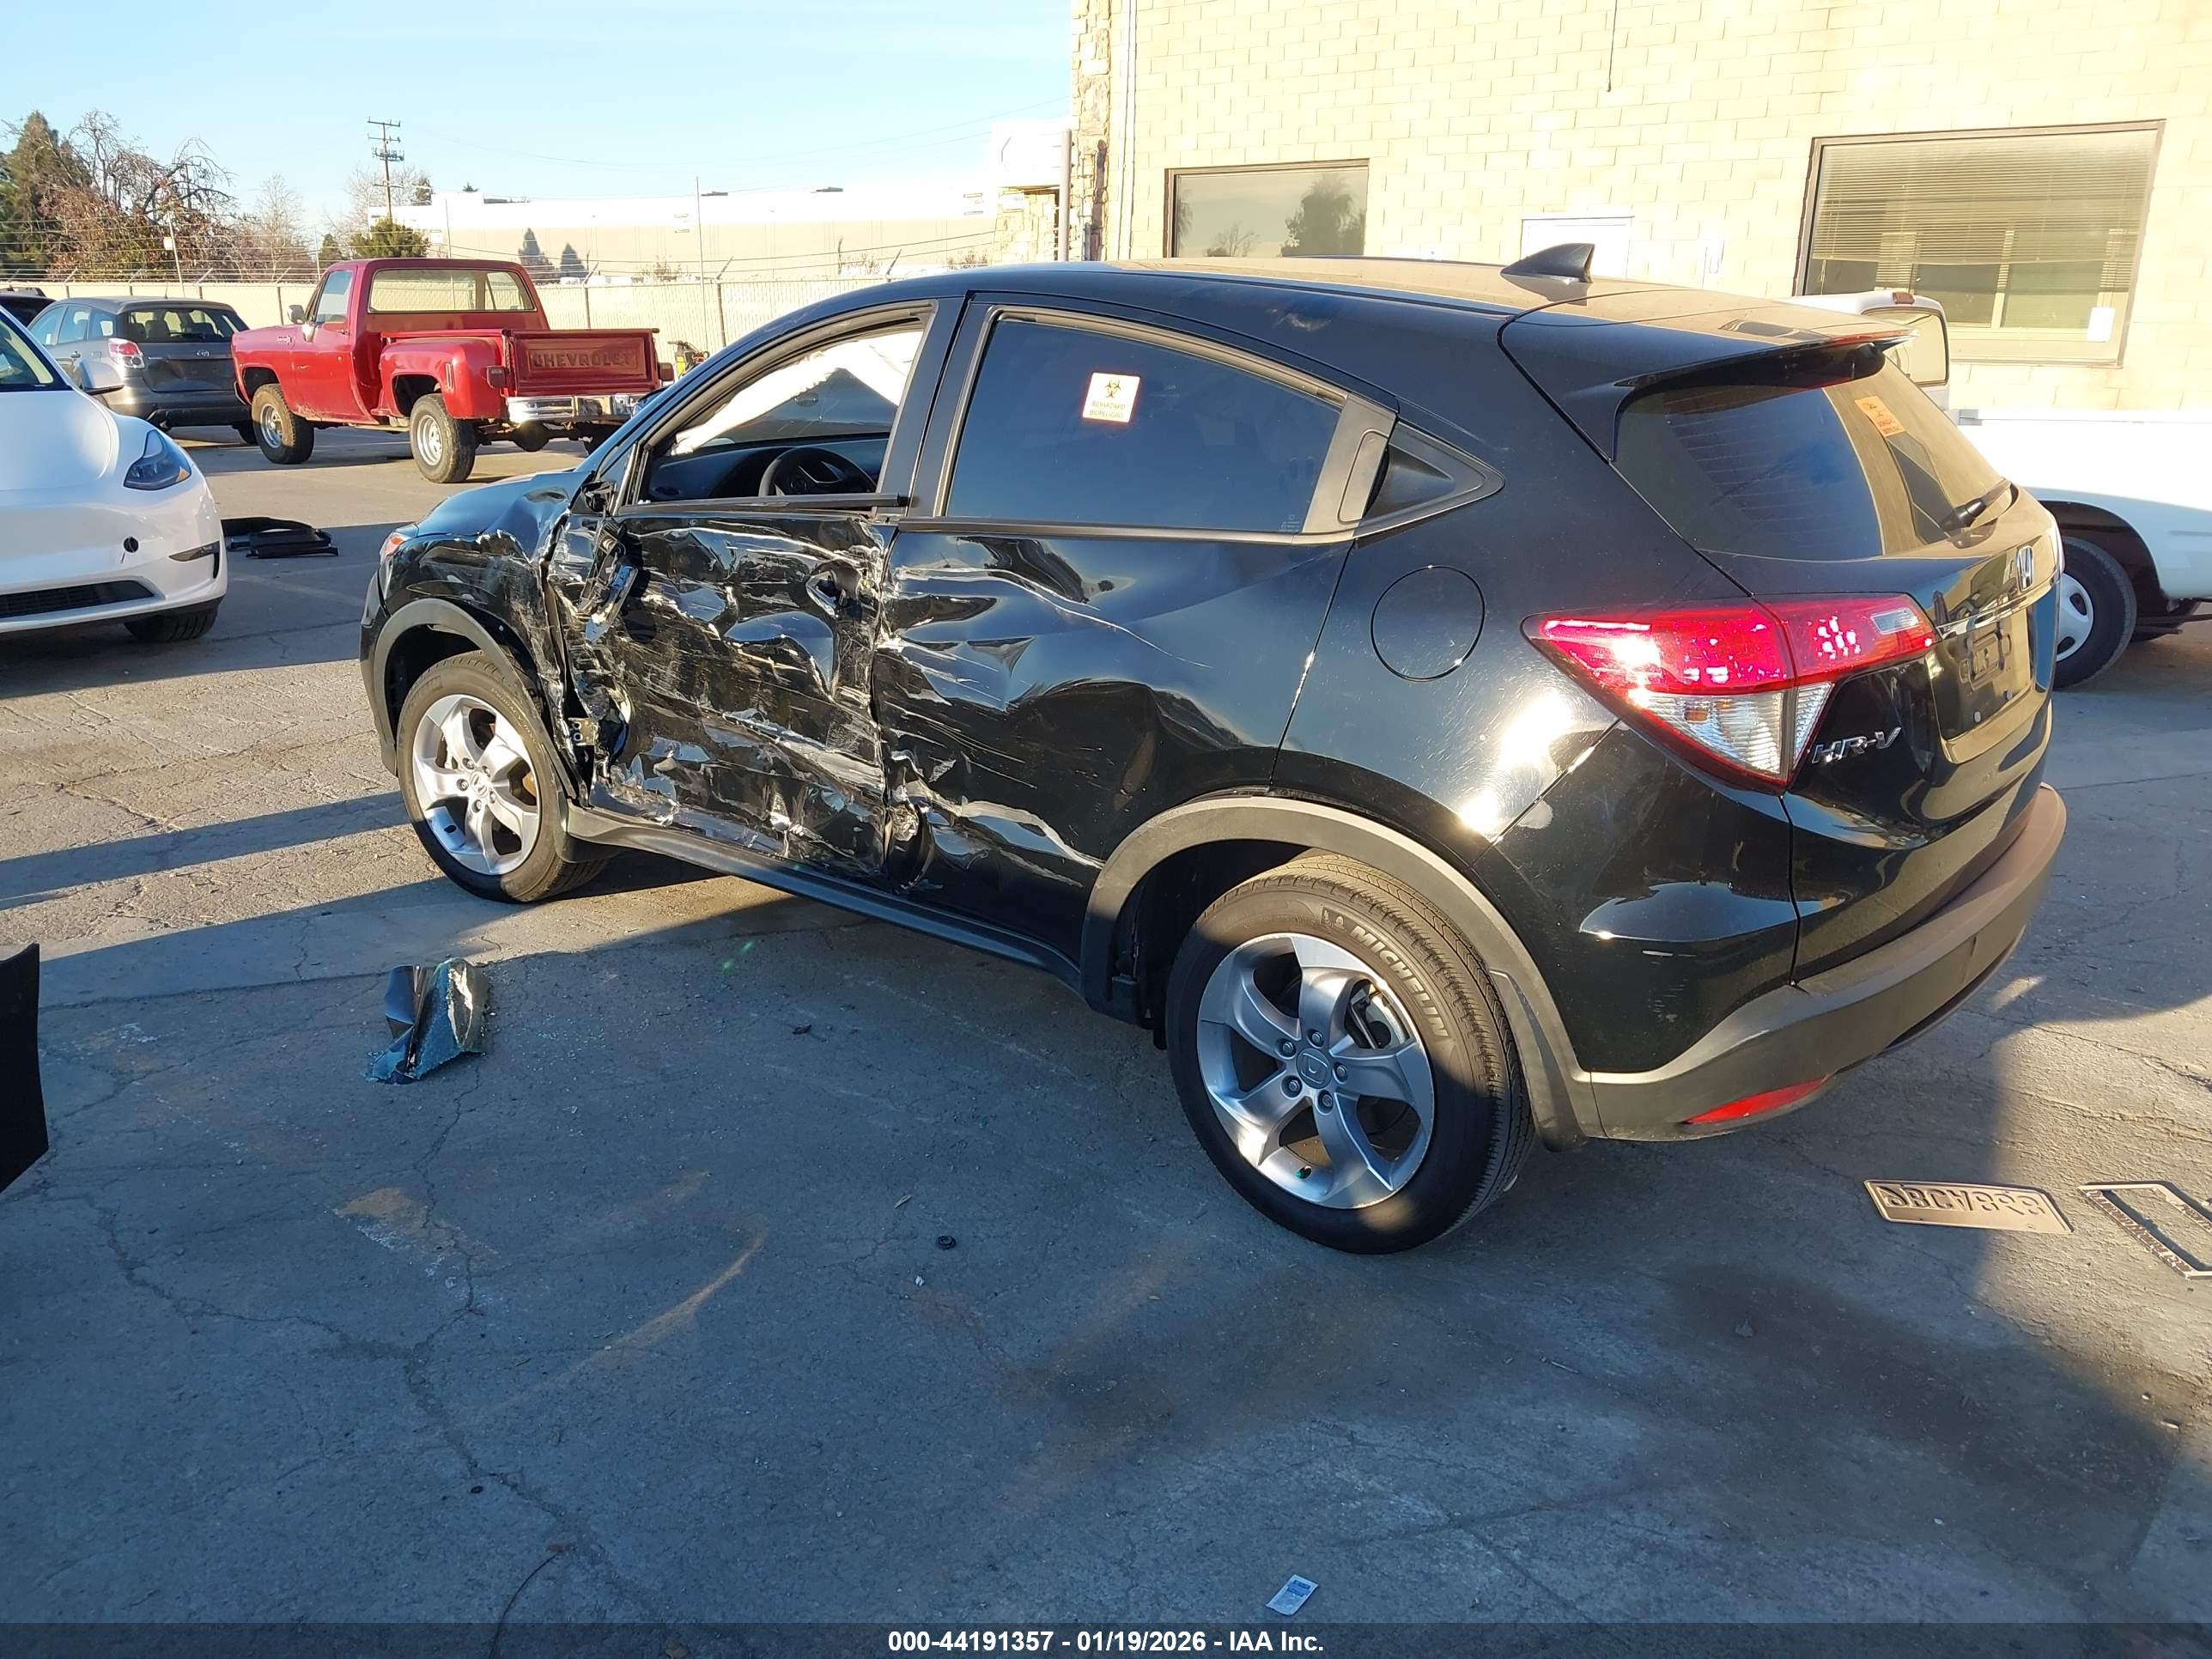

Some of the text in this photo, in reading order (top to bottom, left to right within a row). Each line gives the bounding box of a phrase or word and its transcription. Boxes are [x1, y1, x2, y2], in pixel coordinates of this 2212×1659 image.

[533, 350, 634, 368] CHEVROLET
[1812, 726, 1902, 763] HR-V
[1349, 926, 1449, 1037] MICHELIN
